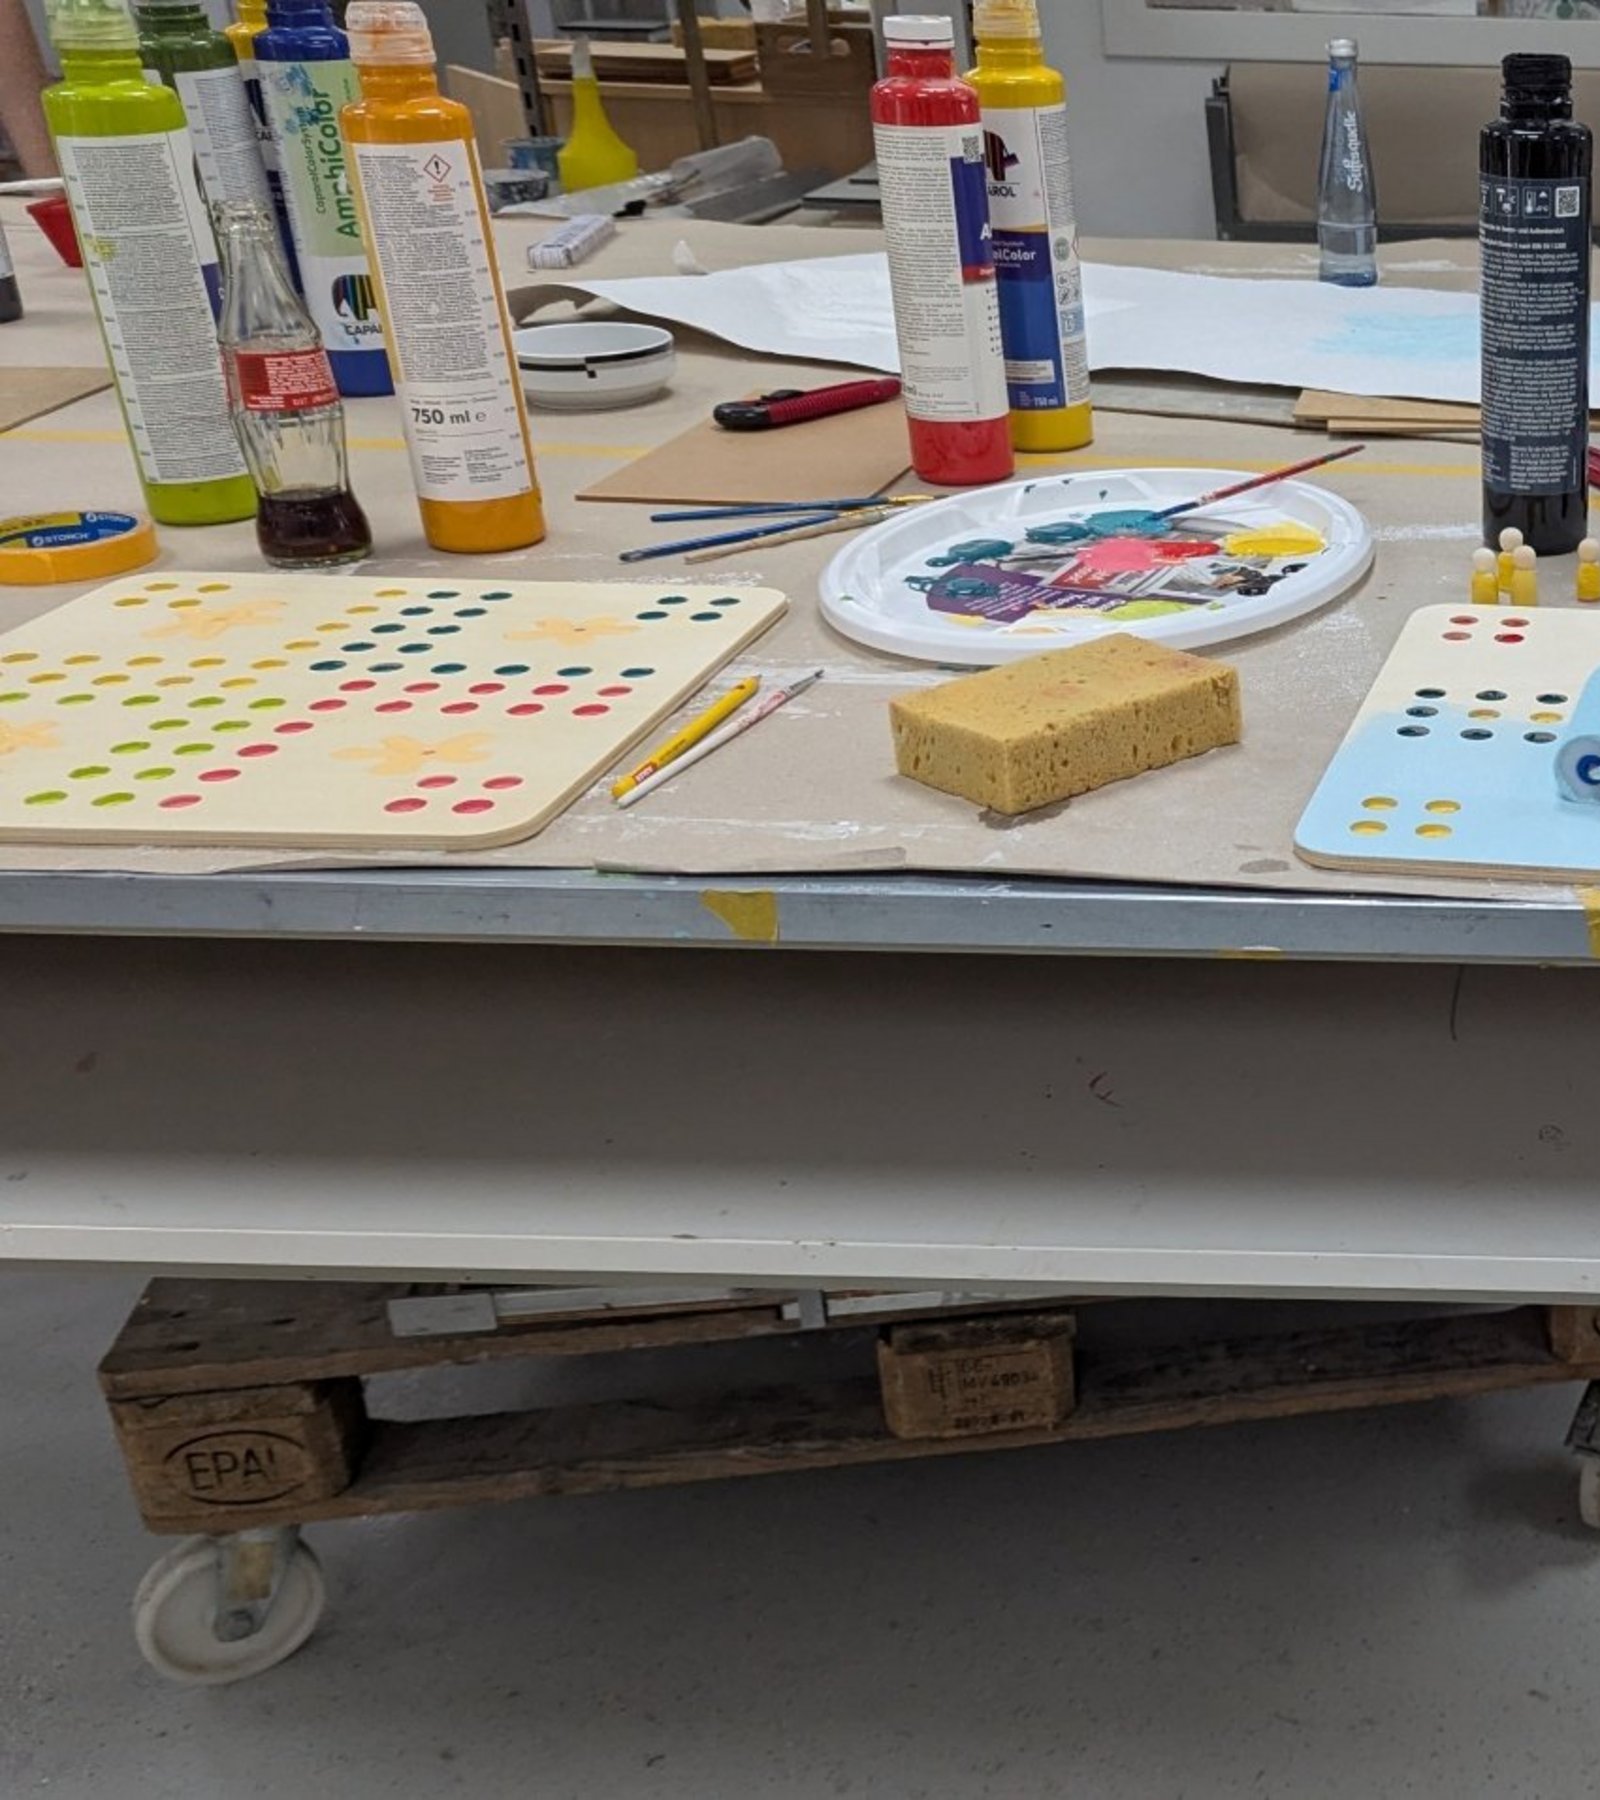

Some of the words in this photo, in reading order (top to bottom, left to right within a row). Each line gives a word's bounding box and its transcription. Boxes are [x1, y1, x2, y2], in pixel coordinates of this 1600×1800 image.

[345, 323, 383, 336] CAPA
[411, 408, 444, 424] 750
[450, 410, 471, 424] ml
[45, 532, 89, 544] STORCH
